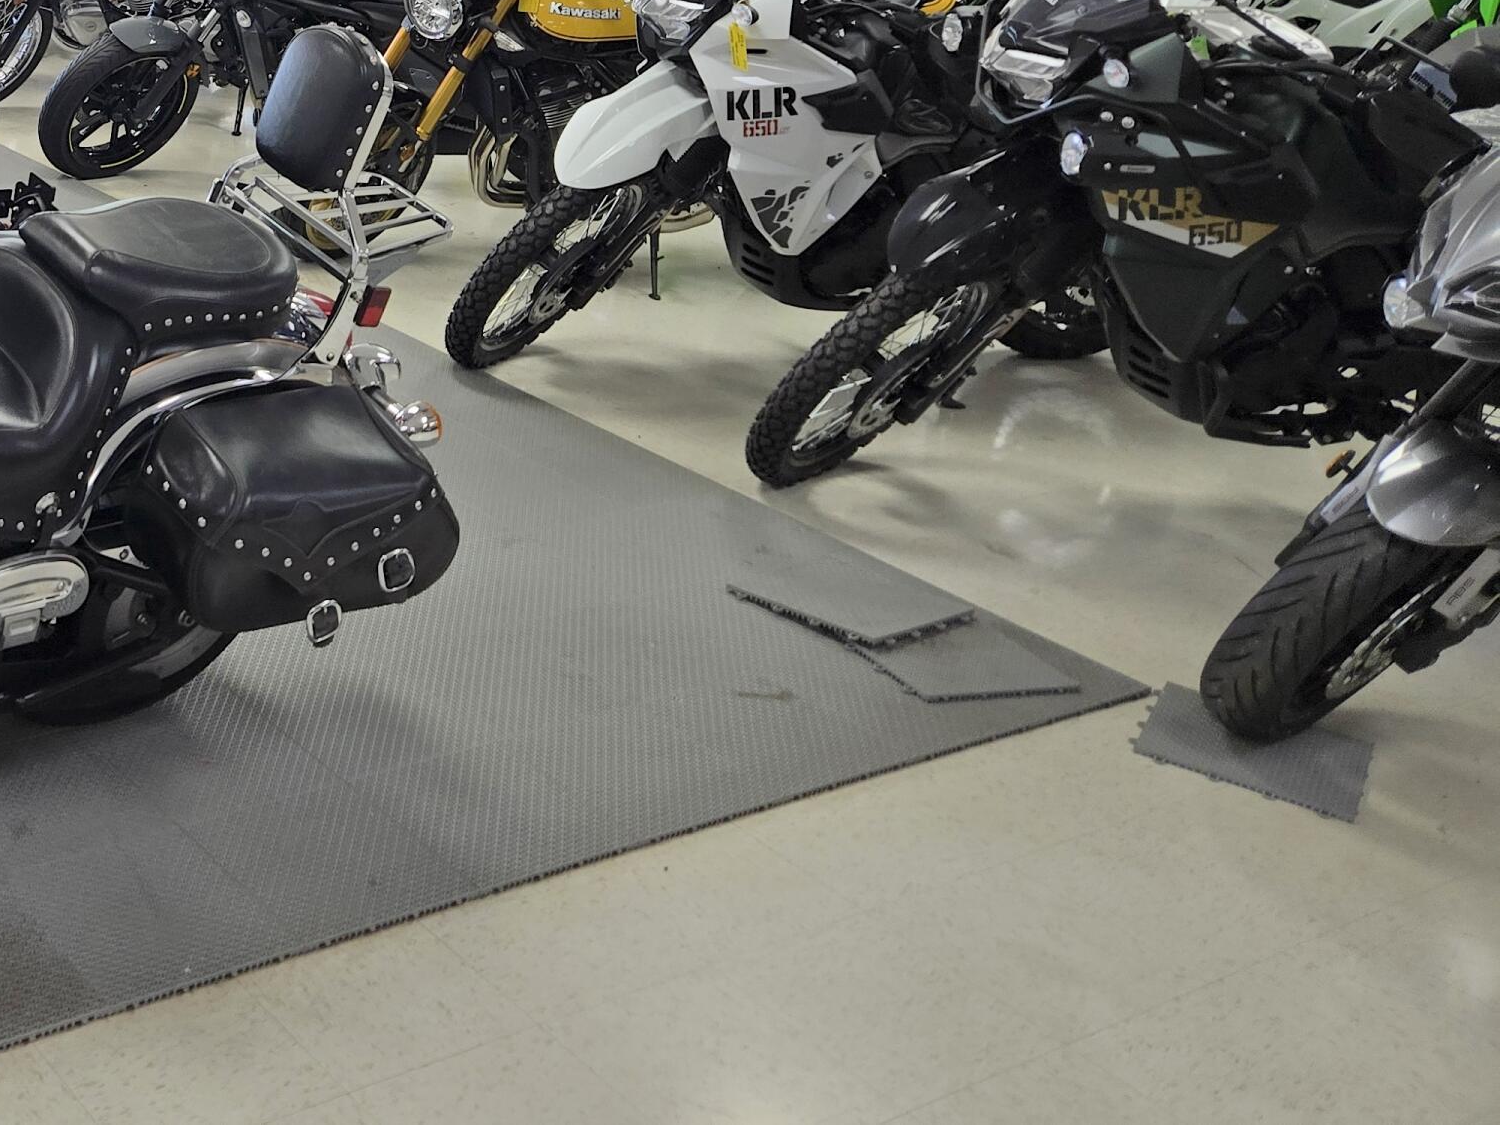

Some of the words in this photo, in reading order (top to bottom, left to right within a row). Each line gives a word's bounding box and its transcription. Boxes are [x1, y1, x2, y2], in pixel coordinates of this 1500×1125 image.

[549, 1, 621, 19] Kawasaki
[726, 86, 798, 121] KLR
[743, 119, 779, 138] 650
[1118, 186, 1204, 221] KLR
[1189, 221, 1243, 246] 650
[1446, 577, 1476, 606] ABS
